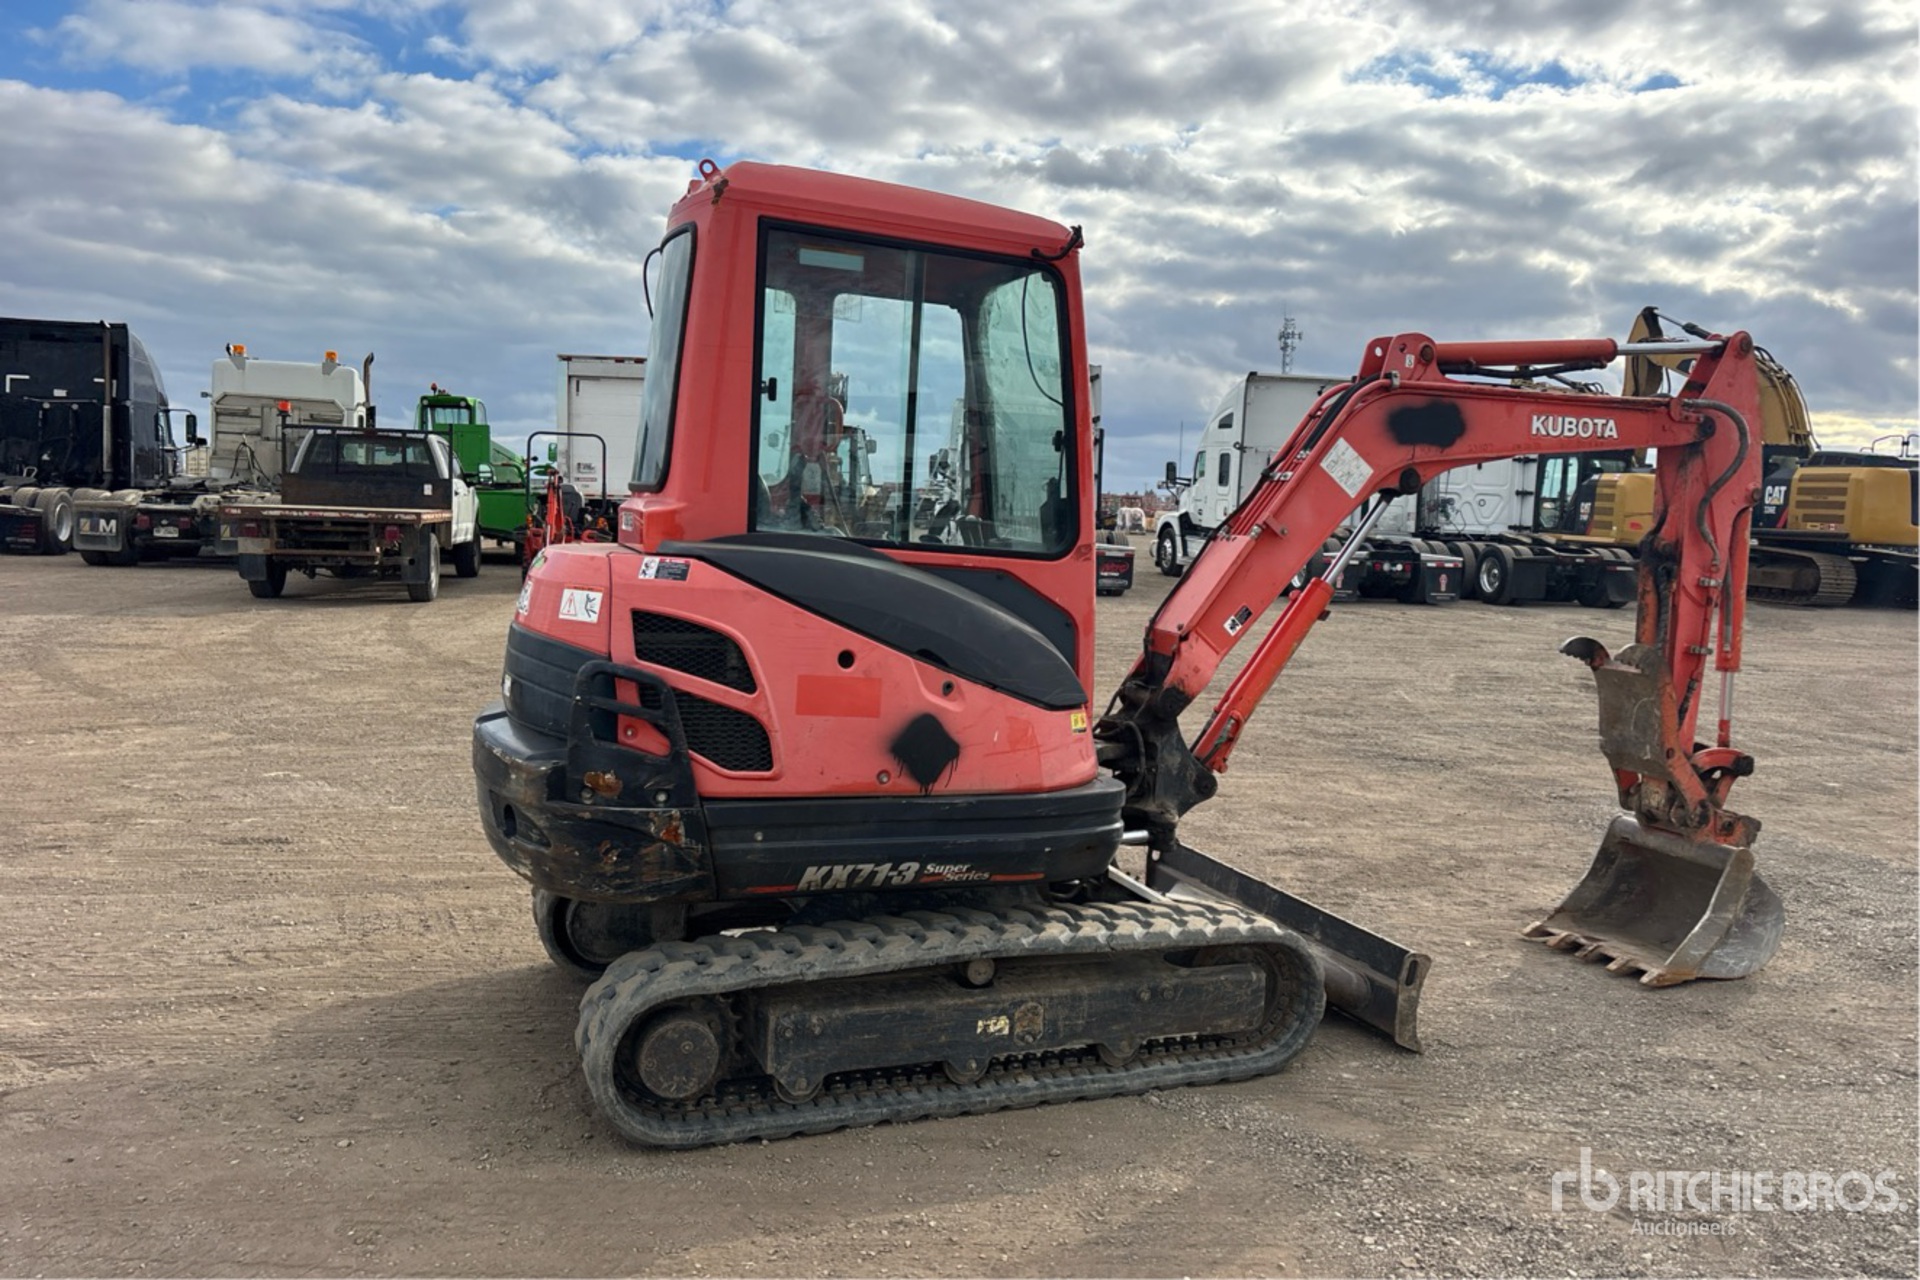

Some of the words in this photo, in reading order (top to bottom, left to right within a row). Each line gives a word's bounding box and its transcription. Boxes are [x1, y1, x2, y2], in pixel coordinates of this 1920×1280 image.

[1532, 415, 1618, 439] KUBOTA
[1764, 486, 1787, 505] CAT
[797, 862, 920, 891] KX71-3
[924, 863, 971, 877] Super
[943, 871, 990, 882] Series
